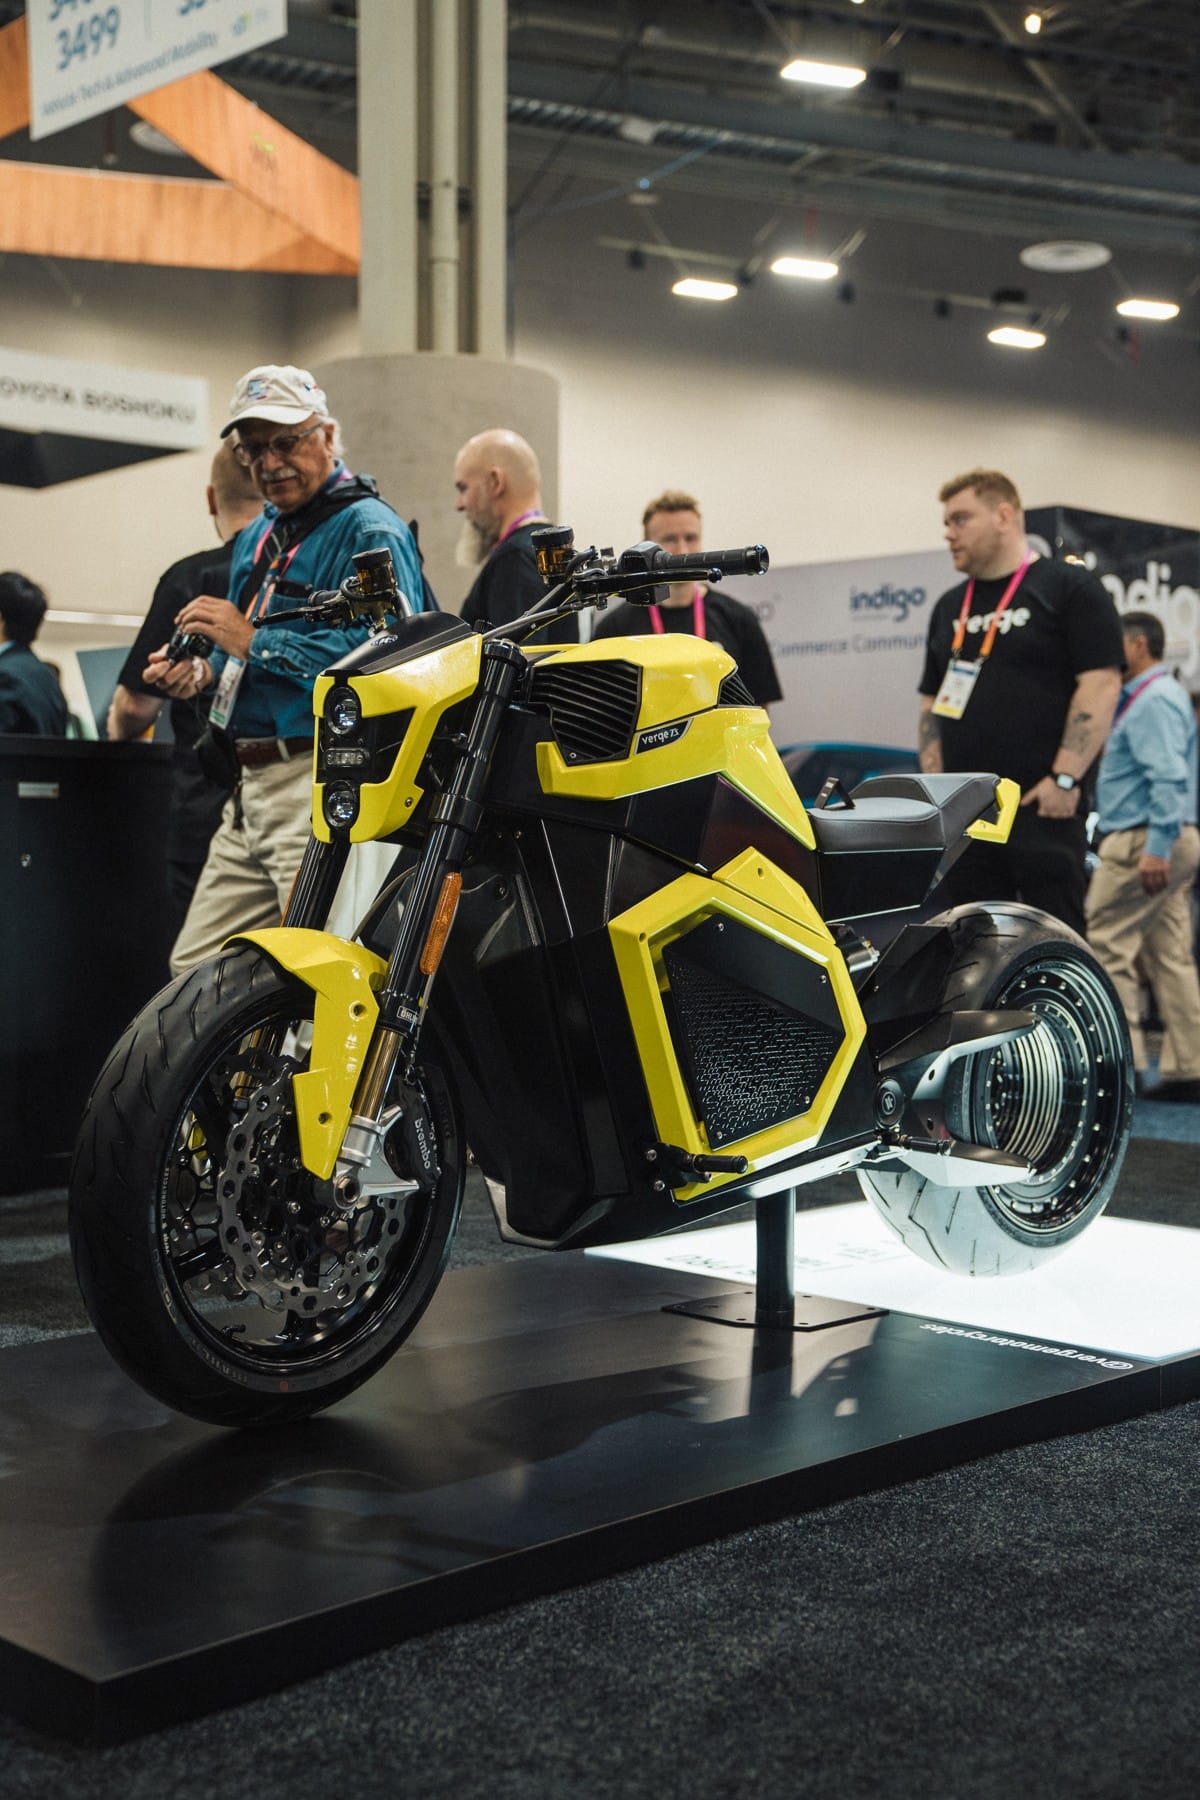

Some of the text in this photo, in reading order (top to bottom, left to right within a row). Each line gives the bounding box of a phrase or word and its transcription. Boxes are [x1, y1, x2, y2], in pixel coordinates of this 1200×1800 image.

[57, 6, 120, 71] 3499
[83, 388, 196, 425] BOSHOKU
[850, 582, 926, 622] indigo
[642, 730, 669, 745] verge
[414, 1117, 431, 1169] brembo
[919, 1322, 1134, 1370] @vergemotorcycles
